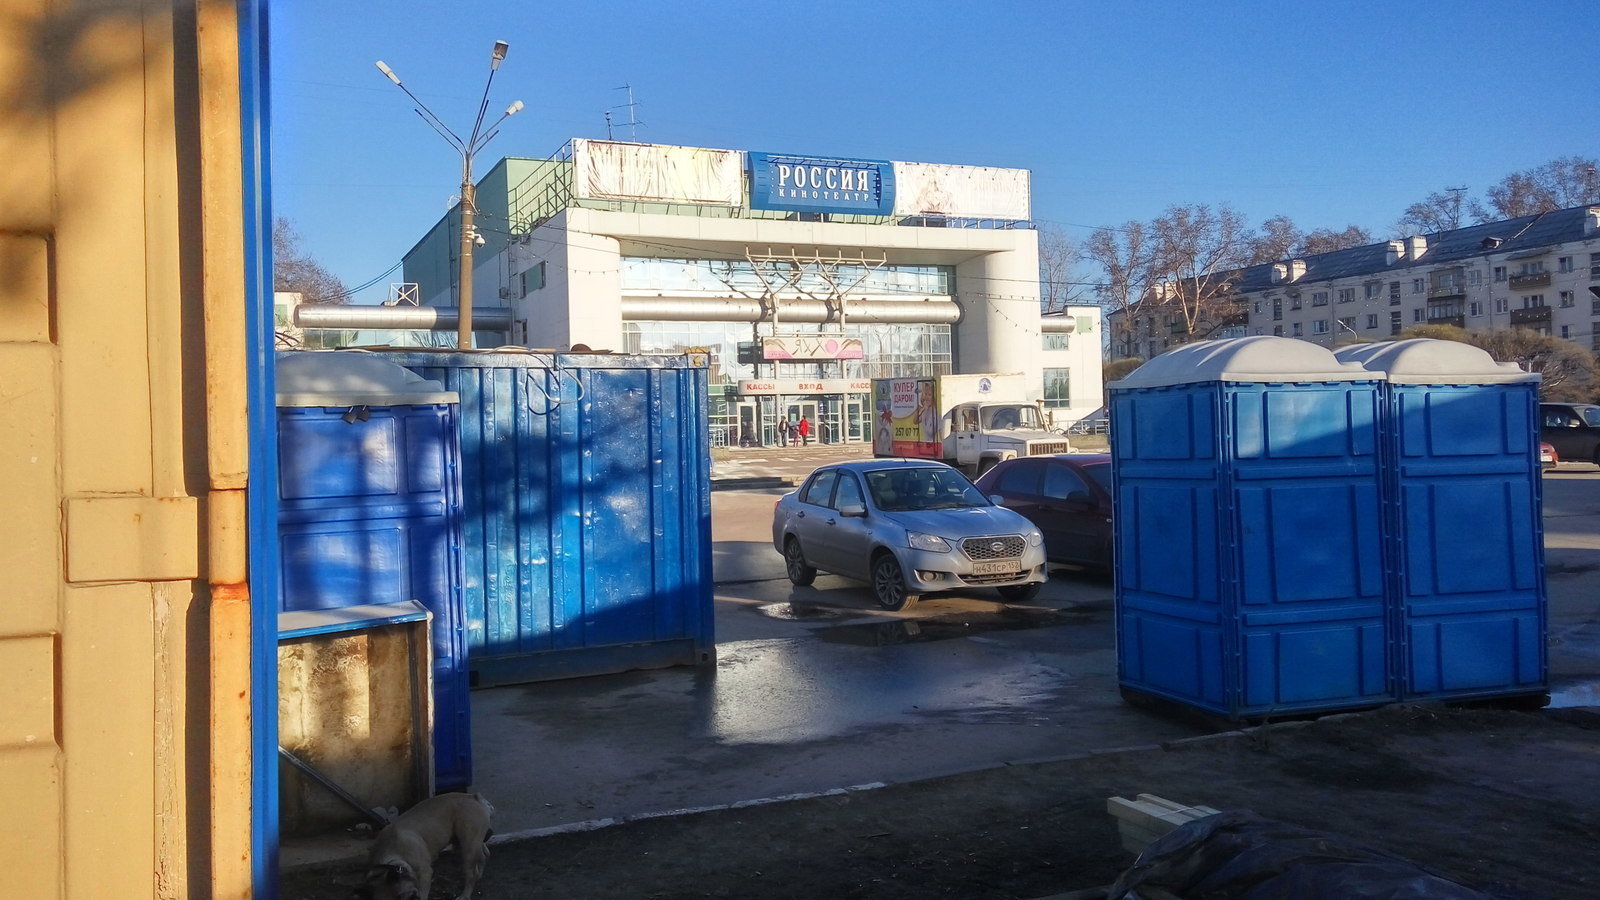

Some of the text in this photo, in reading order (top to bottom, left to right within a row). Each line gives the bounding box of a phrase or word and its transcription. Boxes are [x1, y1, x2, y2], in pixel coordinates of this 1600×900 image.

[778, 165, 869, 191] РОССИЯ
[779, 189, 869, 202] КИНОТЕАТР
[746, 383, 775, 391] КАССЫ
[798, 383, 824, 391] ВХОД
[893, 382, 915, 393] КУПЕР
[894, 394, 915, 404] ДАРОМ!
[895, 427, 920, 437] 257 07 77
